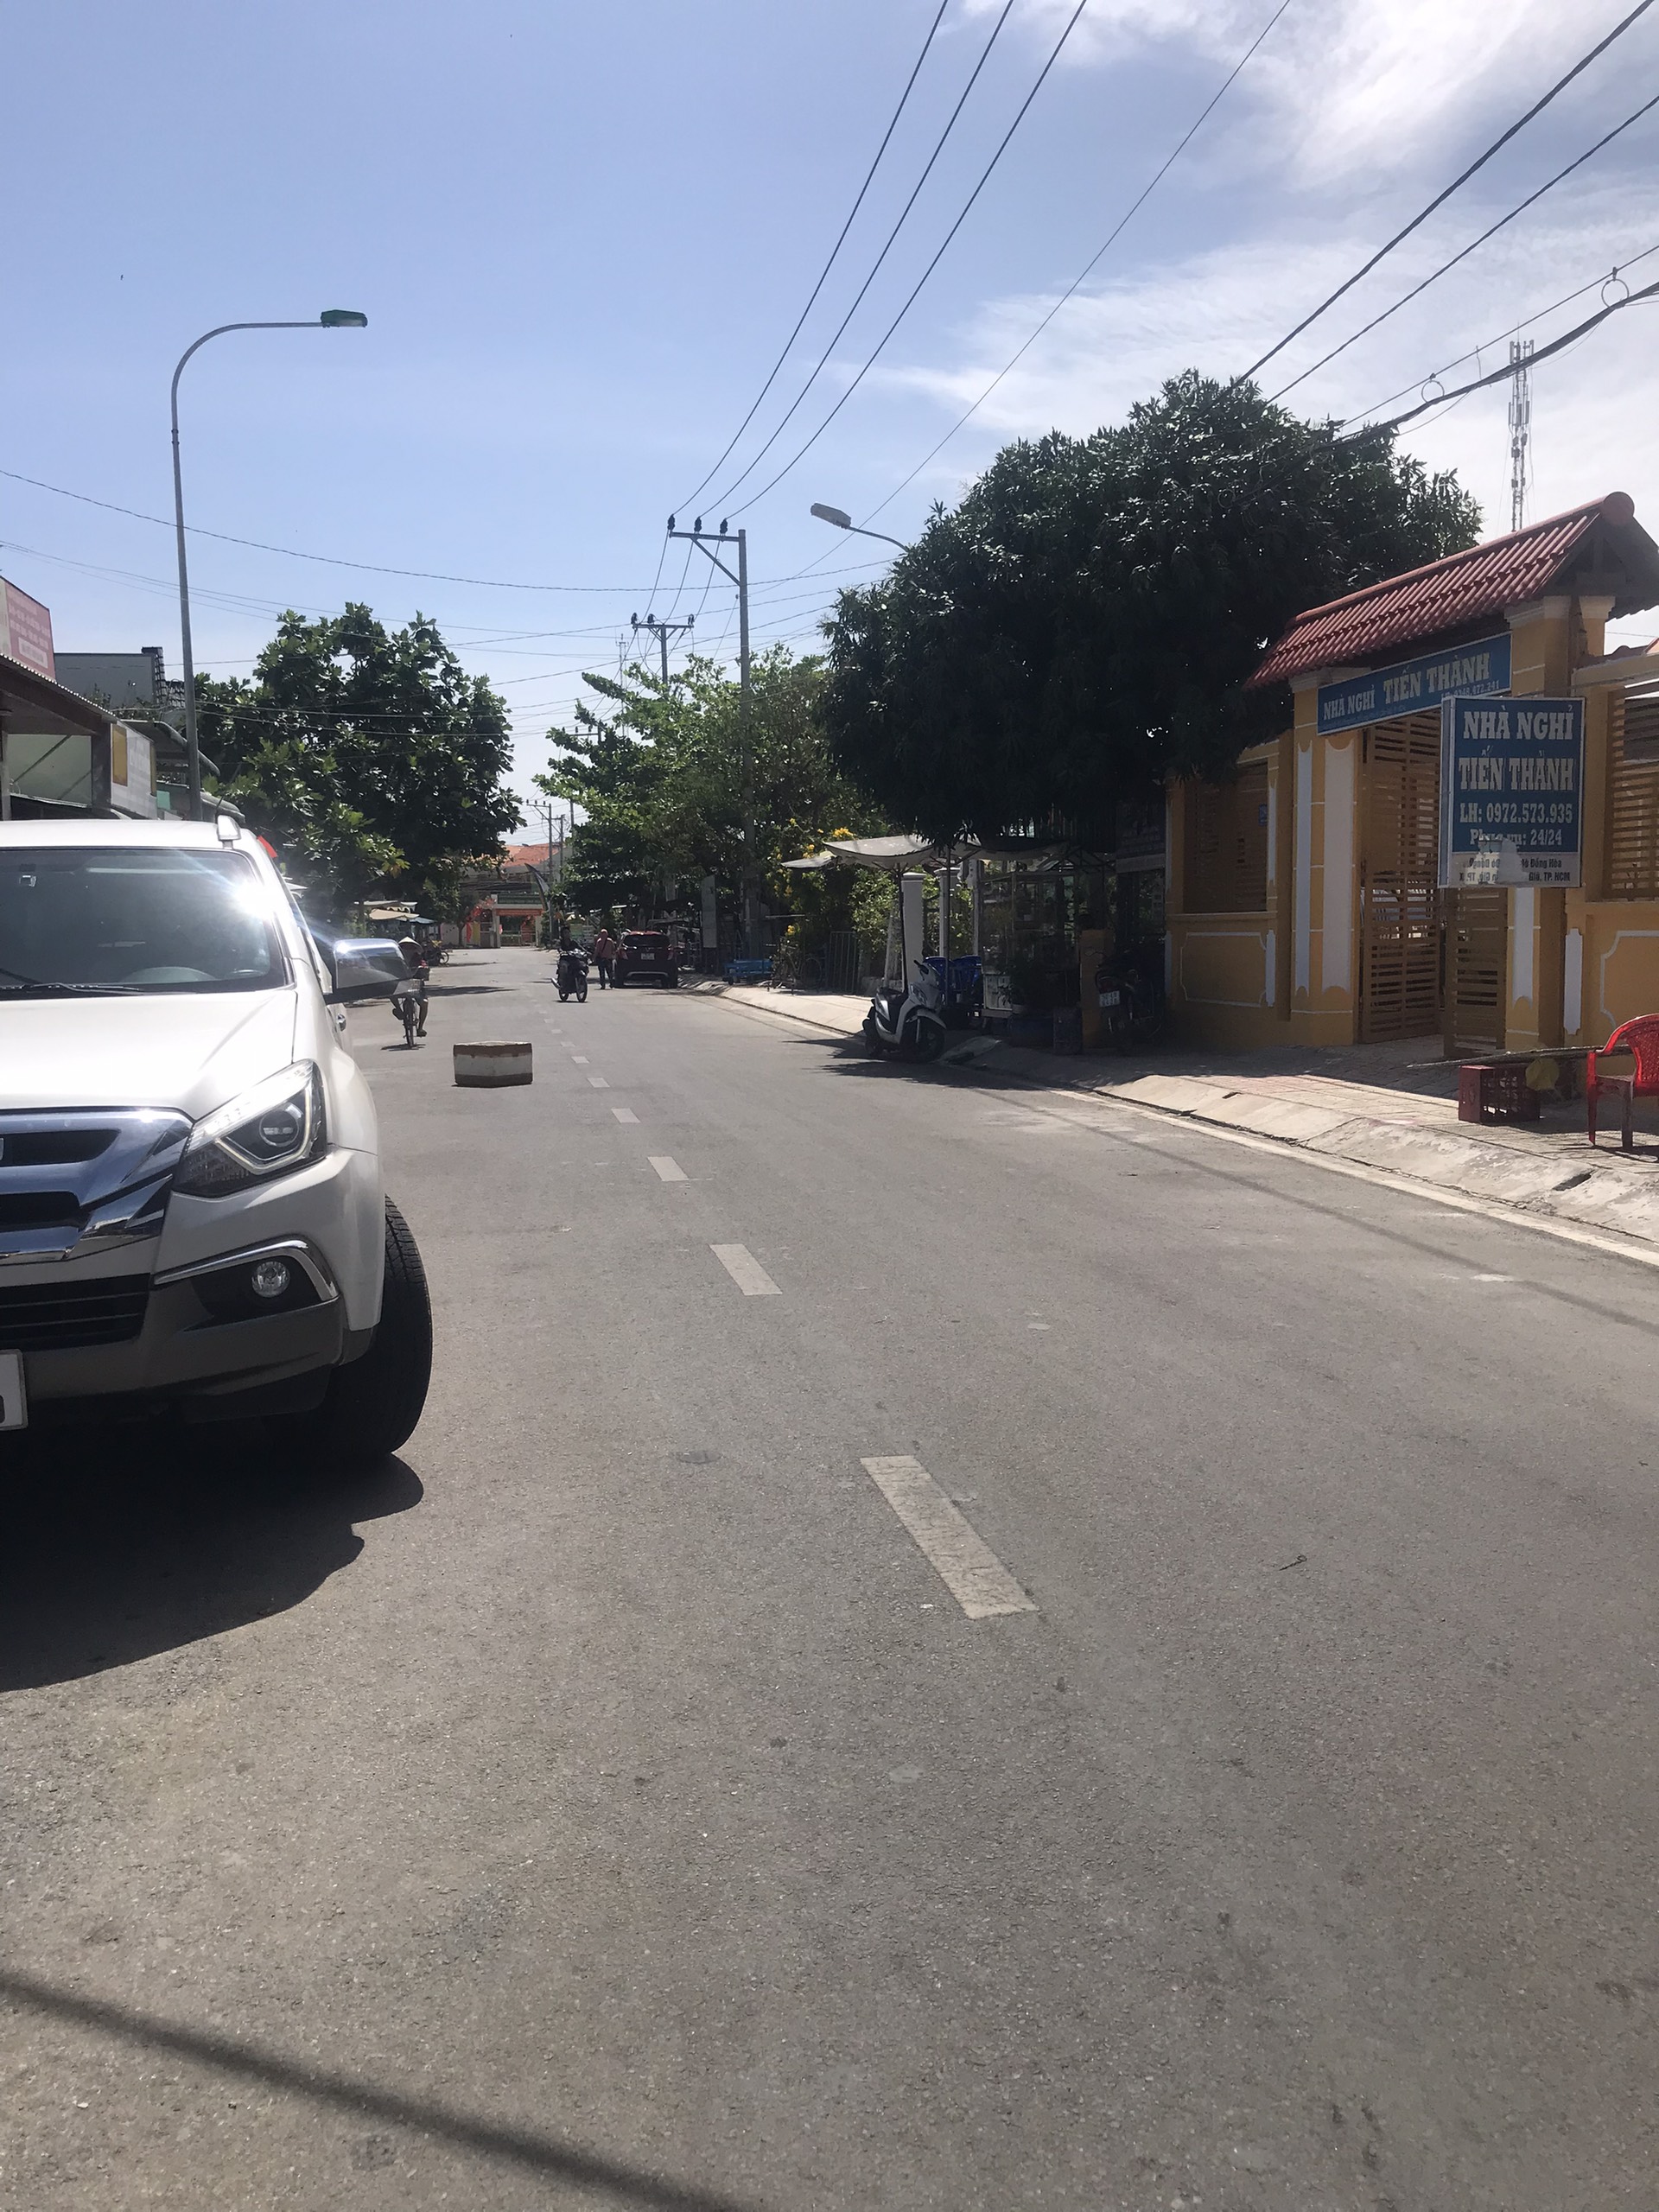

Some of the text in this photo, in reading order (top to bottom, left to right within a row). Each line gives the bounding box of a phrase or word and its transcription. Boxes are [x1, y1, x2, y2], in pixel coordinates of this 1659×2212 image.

[1323, 694, 1345, 720] NHÀ
[1347, 684, 1375, 715] NGHỈ
[1383, 664, 1421, 704] TIẾN
[1426, 652, 1491, 692] THÀNH
[1464, 705, 1573, 740] NHÀ NGHỈ
[1459, 745, 1573, 791] TIẾN THÀNH
[1459, 803, 1573, 823] LH: 0972.573.935
[1530, 829, 1562, 846] 24/24
[1543, 872, 1553, 881] TP.
[1554, 872, 1570, 881] HCM
